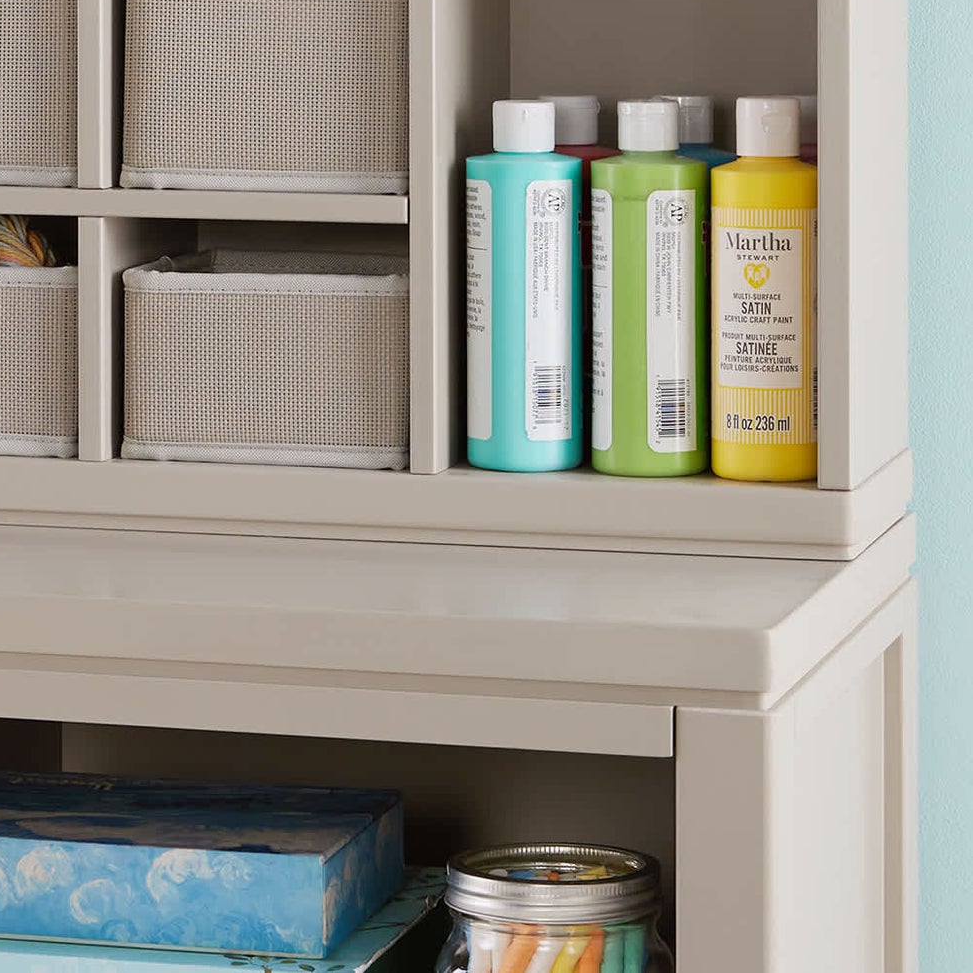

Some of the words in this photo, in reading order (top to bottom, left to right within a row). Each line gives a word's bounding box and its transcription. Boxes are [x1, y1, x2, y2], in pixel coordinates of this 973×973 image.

[548, 193, 560, 212] AP
[670, 203, 683, 222] AP
[725, 231, 792, 250] Martha
[733, 292, 781, 300] MULTI-SURFACE
[741, 301, 772, 315] SATIN
[724, 315, 748, 323] ACRYLIC
[750, 316, 770, 324] CRAFT
[773, 316, 793, 324] PAINT
[722, 331, 744, 340] PRODUIT
[746, 333, 796, 342] MULTI-SURFACE
[736, 340, 778, 355] SATINÉE
[724, 354, 752, 364] PEINTURE
[755, 356, 792, 364] ACRYLIQUE
[735, 364, 798, 372] LOISIRS-CRÉATIONS
[726, 413, 732, 429] 8
[733, 414, 739, 429] fl
[742, 418, 753, 430] oz
[756, 416, 775, 431] 236
[778, 416, 790, 431] ml
